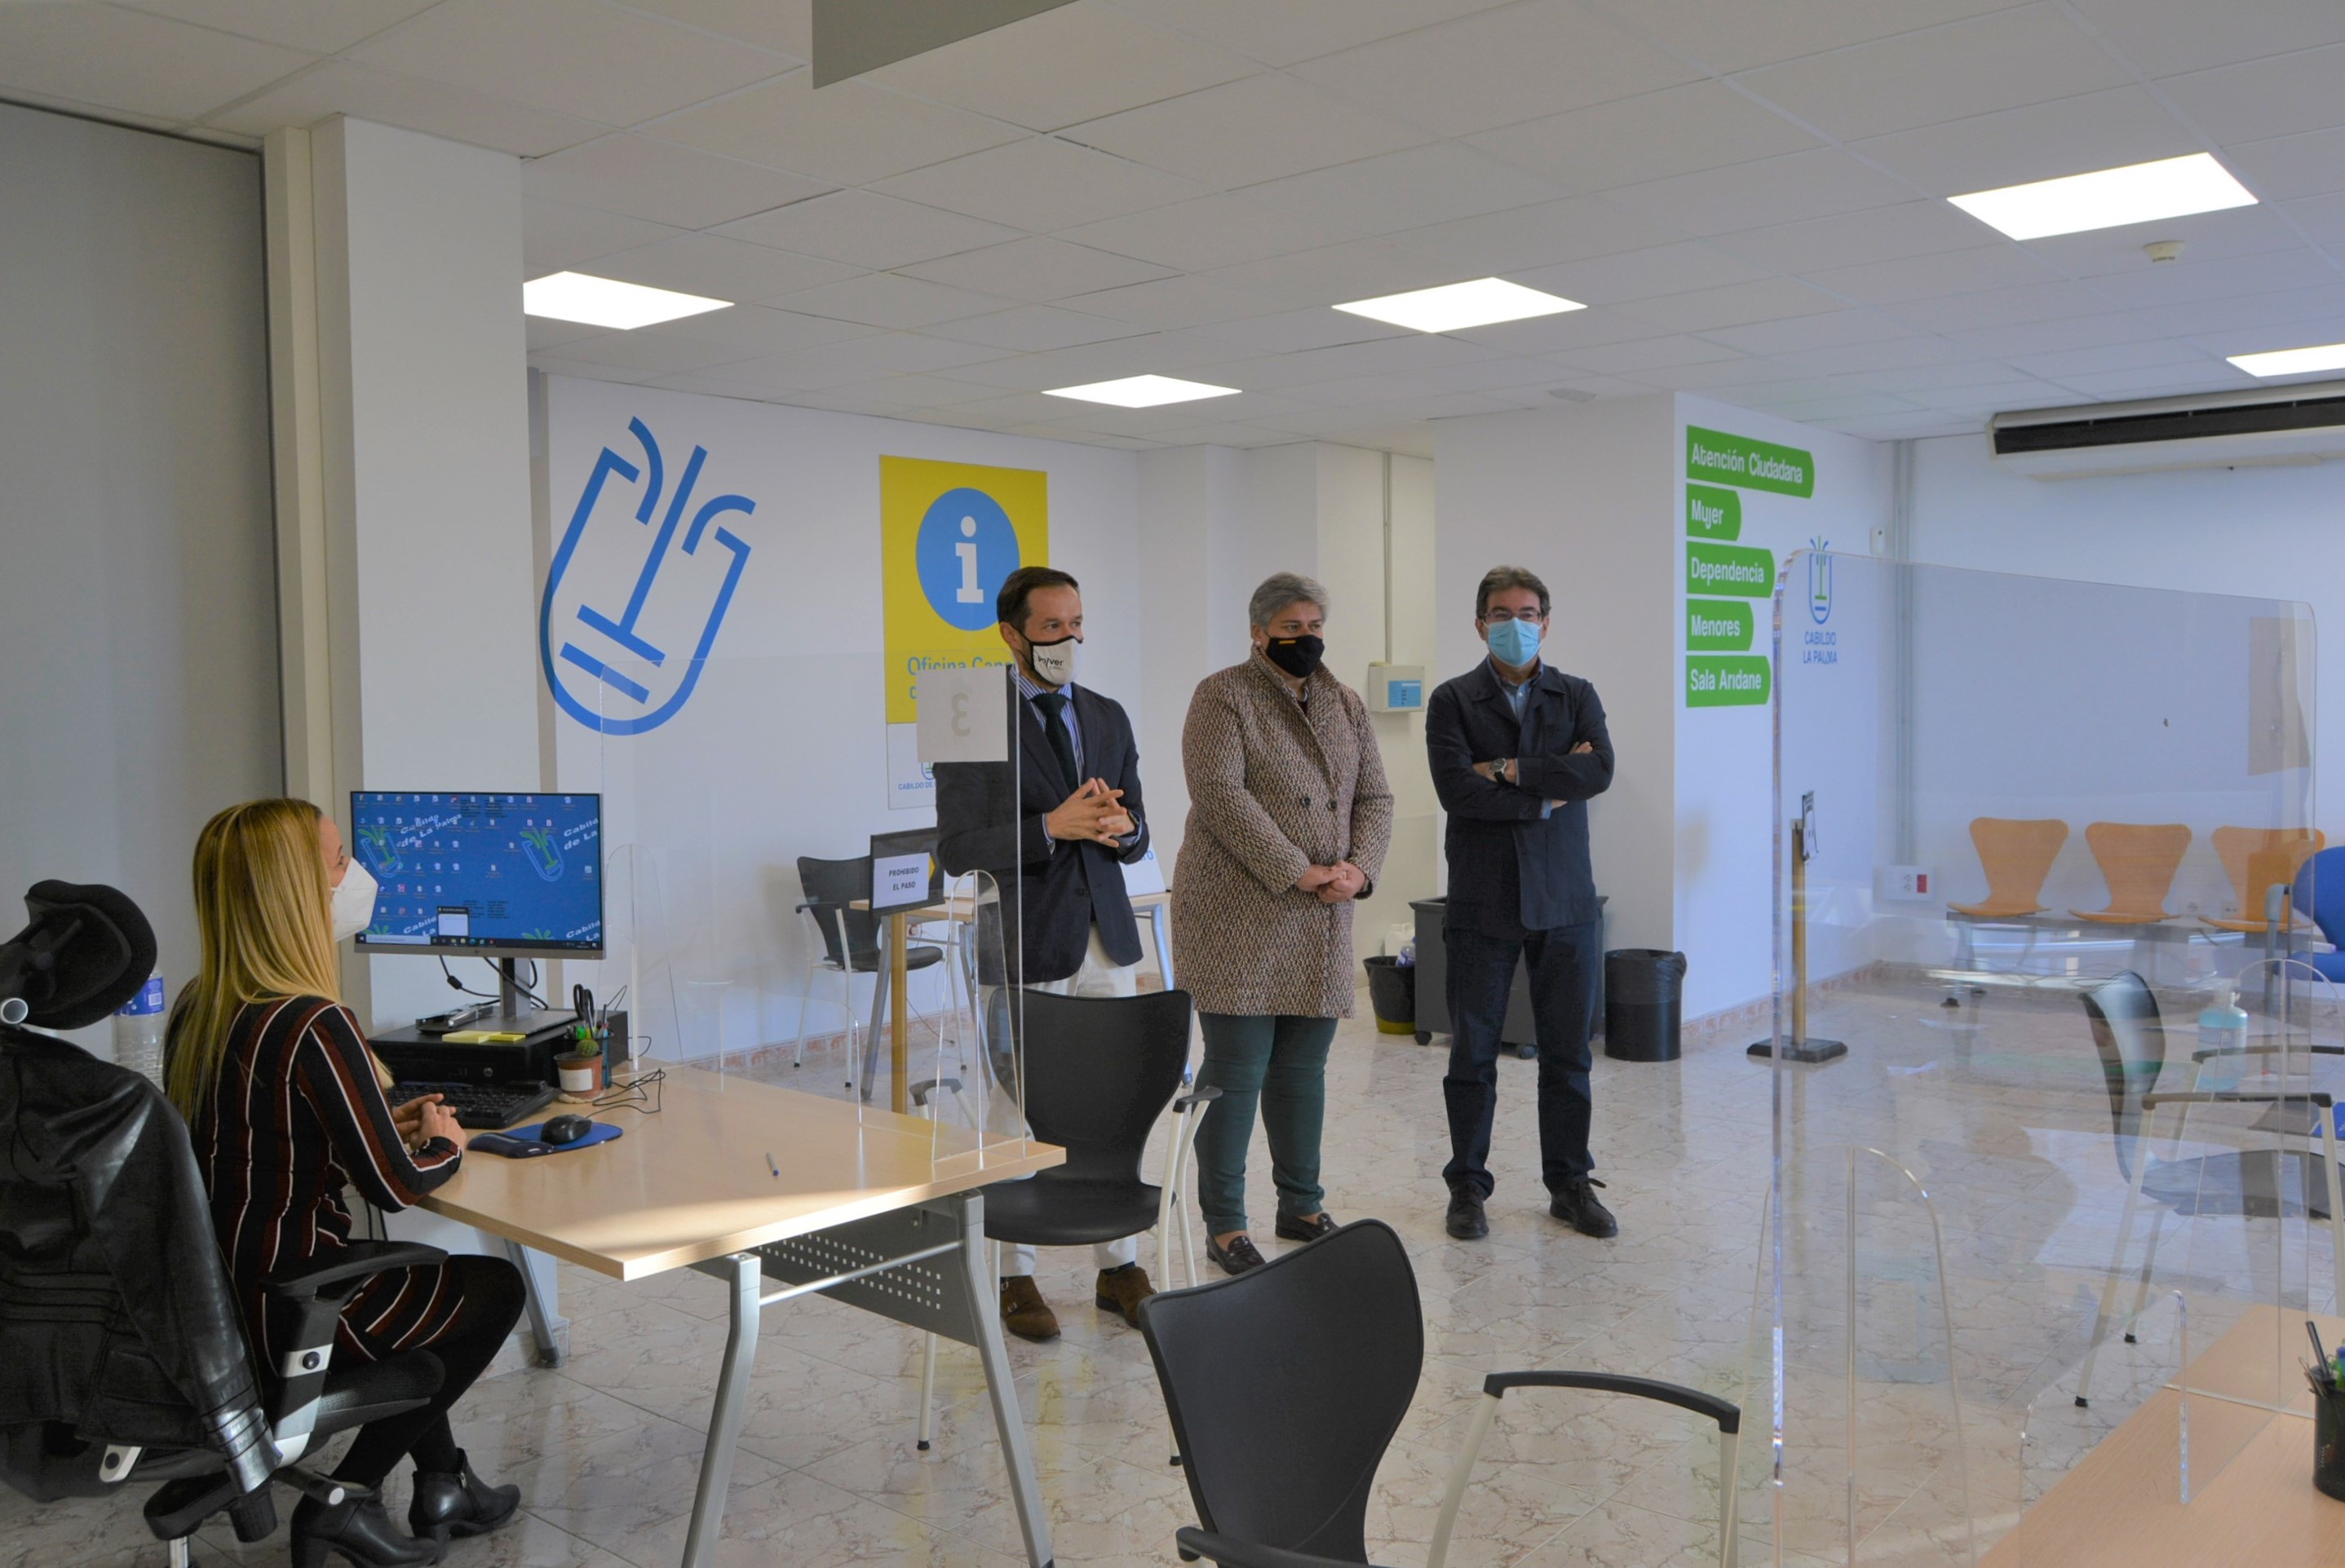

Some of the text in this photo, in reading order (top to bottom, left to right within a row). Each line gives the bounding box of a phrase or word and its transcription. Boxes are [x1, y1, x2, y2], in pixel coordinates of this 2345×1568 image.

[1692, 444, 1803, 484] Atención Ciudadana
[1692, 499, 1723, 530] Mujer
[1691, 557, 1764, 586] Dependencia
[1691, 615, 1741, 637] Menores
[1805, 631, 1837, 645] CABILDO
[1803, 650, 1812, 664] LA
[1691, 669, 1762, 691] Sala Aridane
[888, 867, 919, 877] PROHIBIDO
[892, 881, 916, 891] EL PASO
